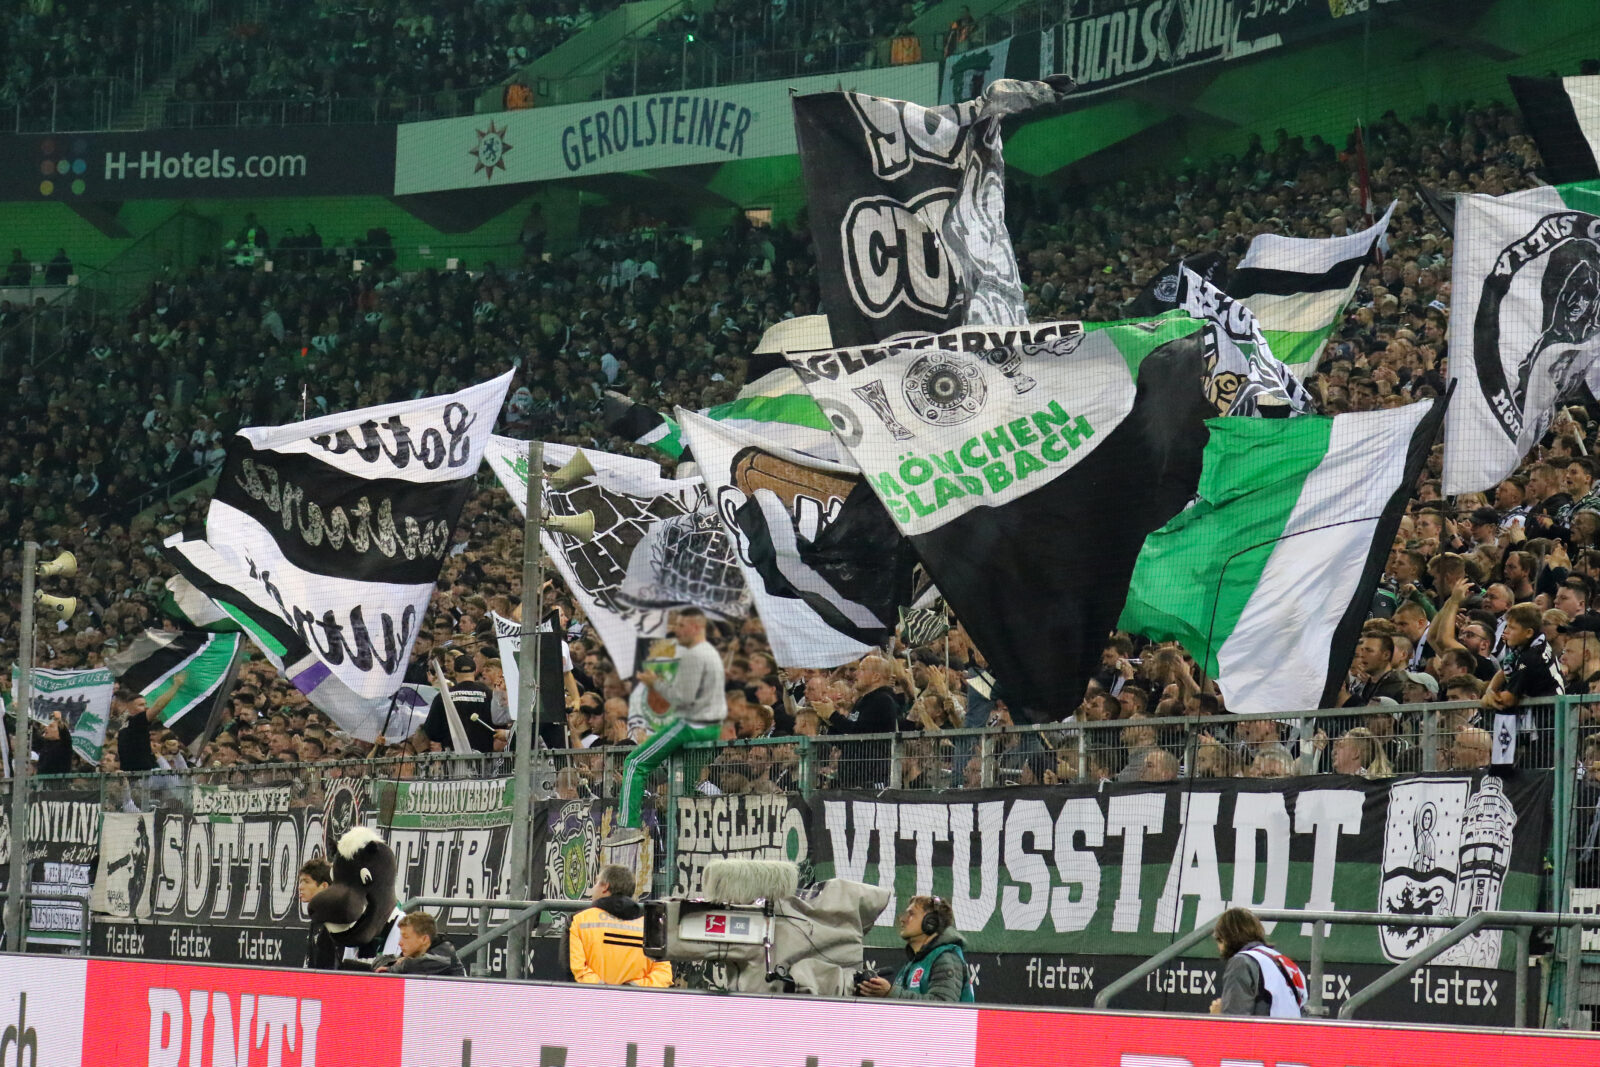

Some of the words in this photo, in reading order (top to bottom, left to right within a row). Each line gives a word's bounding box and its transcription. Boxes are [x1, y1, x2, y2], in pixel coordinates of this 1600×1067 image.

[561, 97, 751, 171] GEROLSTEINER
[105, 150, 306, 180] H-Hotels.com
[870, 399, 1071, 497] MÖNCHEN
[885, 415, 1096, 524] GLADBACH
[407, 777, 506, 814] STADIONVERBOT
[22, 800, 100, 845] ONTLINE
[678, 794, 788, 851] BEGLEIT
[824, 790, 1365, 938] VITUSSTADT
[106, 926, 145, 955] flatex
[170, 929, 211, 958] flatex
[238, 931, 282, 961] flatex
[1026, 957, 1094, 990] flatex
[1410, 968, 1498, 1007] flatex
